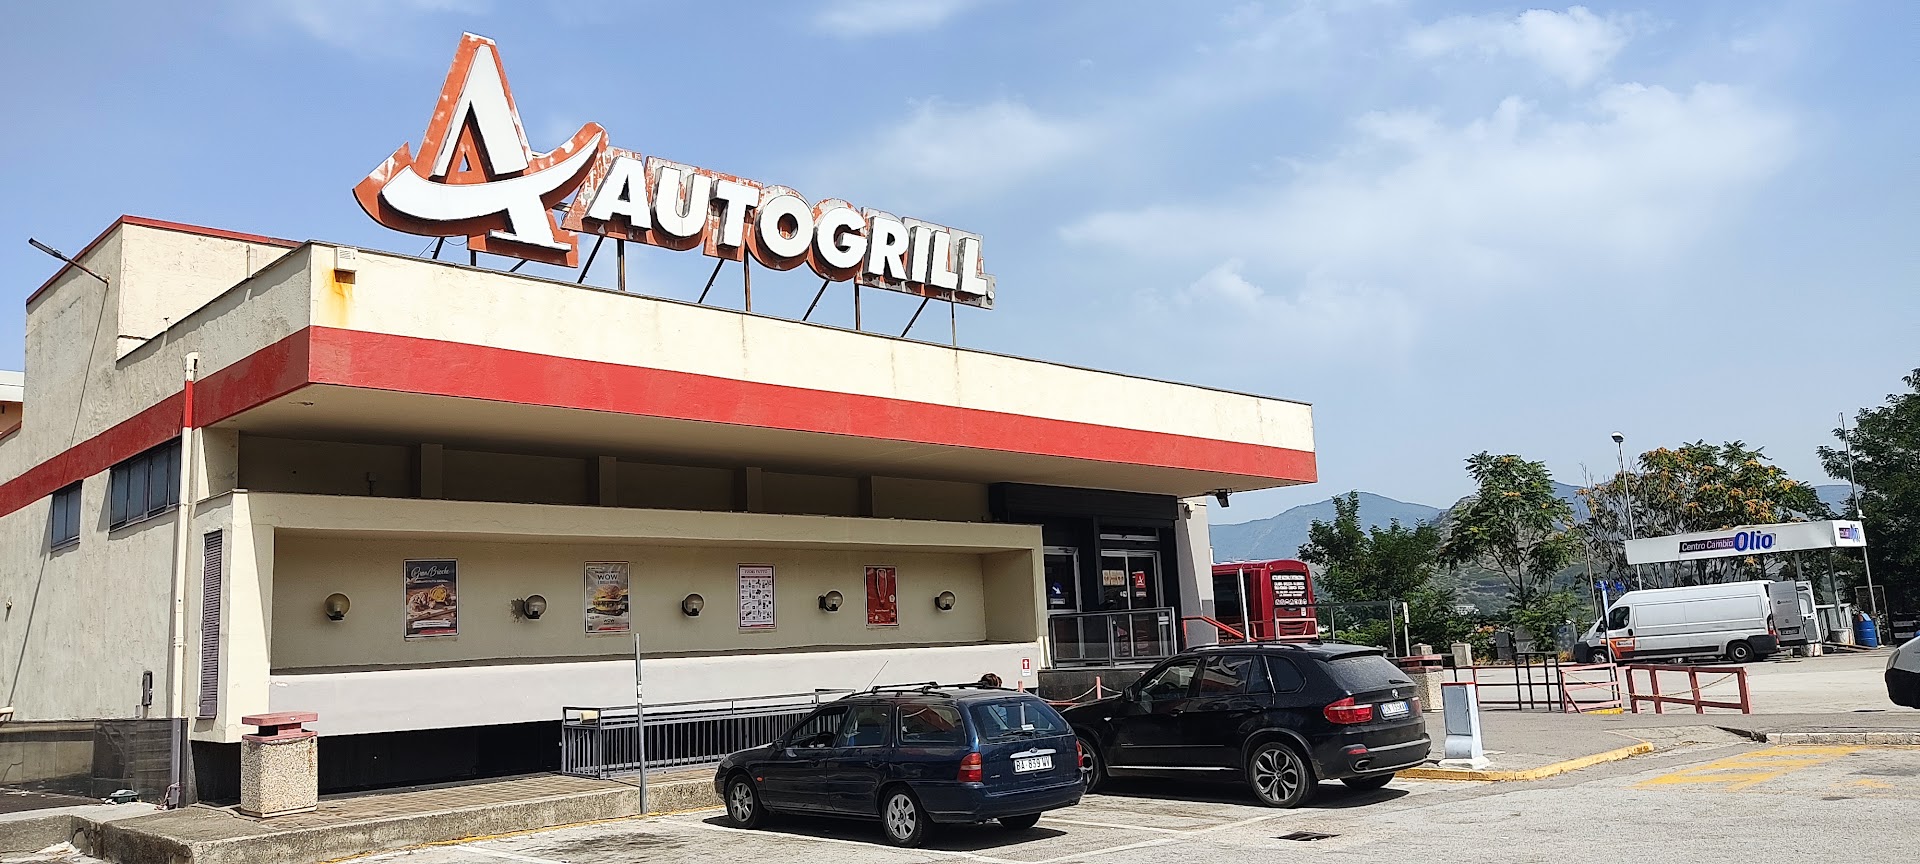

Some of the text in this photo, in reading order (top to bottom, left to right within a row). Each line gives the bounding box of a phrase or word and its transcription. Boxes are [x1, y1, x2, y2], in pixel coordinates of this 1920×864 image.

[582, 152, 992, 301] AUTOGRILL
[1681, 529, 1774, 552] Centro Cambio Olio
[1016, 760, 1026, 771] BA
[1028, 758, 1041, 769] 839
